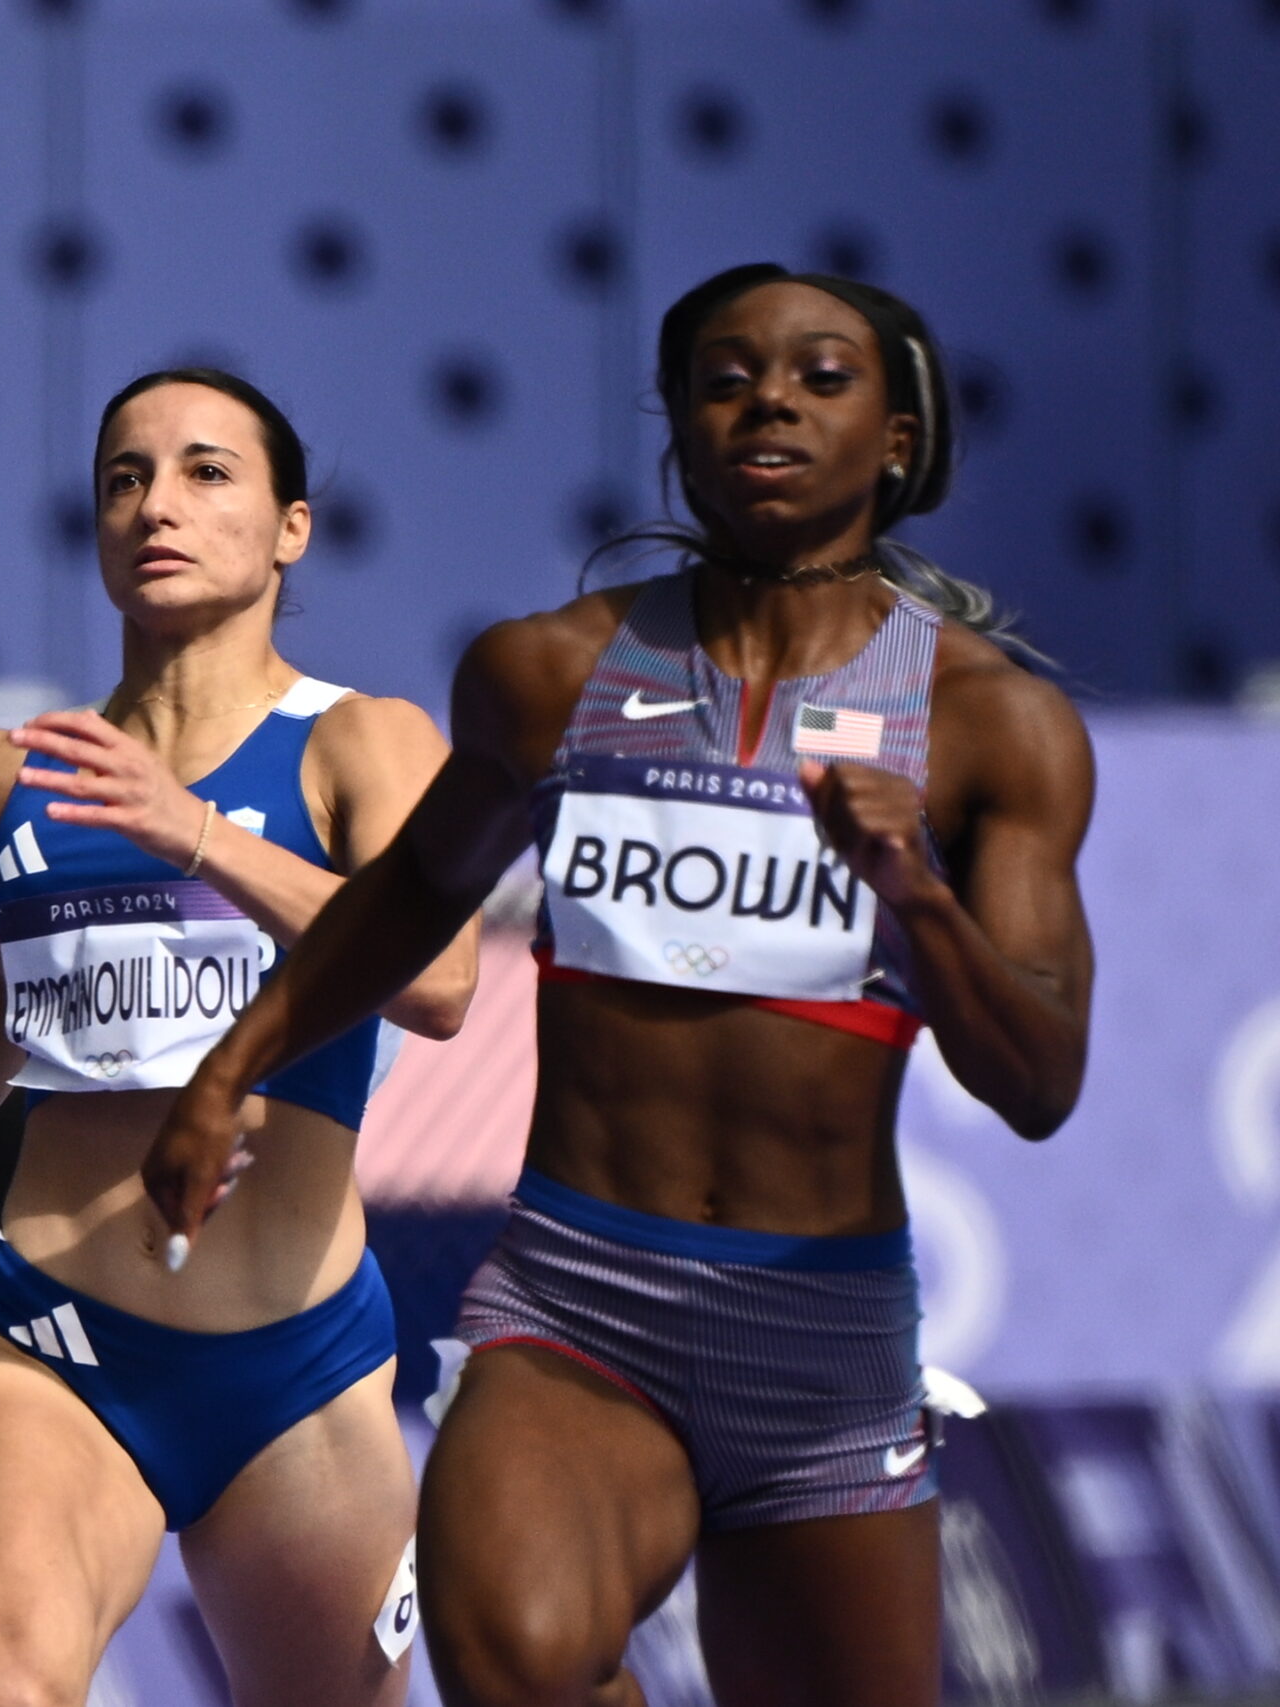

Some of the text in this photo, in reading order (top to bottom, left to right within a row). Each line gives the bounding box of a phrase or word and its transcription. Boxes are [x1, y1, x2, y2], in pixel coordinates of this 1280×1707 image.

[645, 768, 804, 806] PARIS 2024
[50, 893, 176, 922] PARIS 2024
[562, 835, 859, 932] BROWN
[12, 956, 248, 1043] EMMANOUILIDOU
